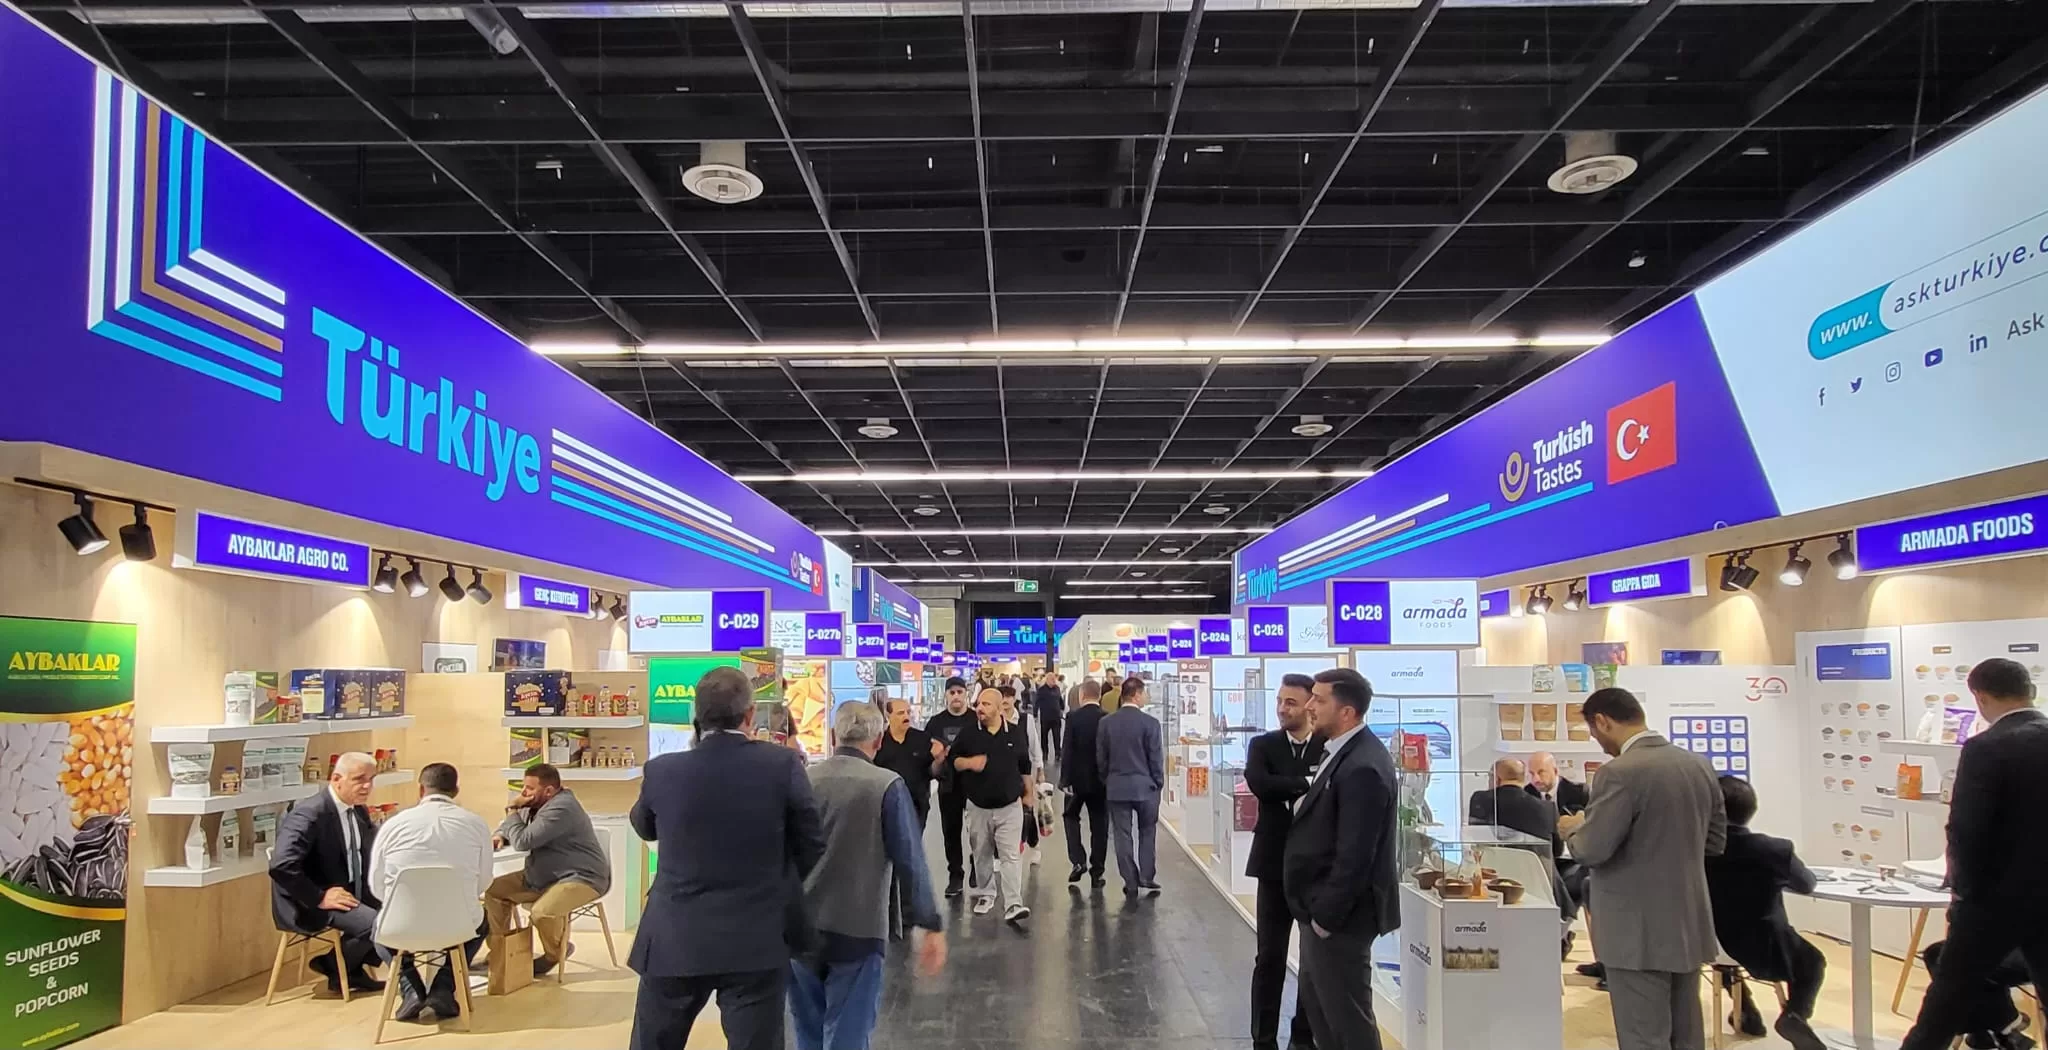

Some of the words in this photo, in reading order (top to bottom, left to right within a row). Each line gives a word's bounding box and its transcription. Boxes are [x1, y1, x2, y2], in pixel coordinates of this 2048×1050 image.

[1820, 312, 1873, 345] www.
[2007, 312, 2044, 340] Ask
[312, 306, 541, 501] Türkiye
[1533, 420, 1593, 465] Turkish
[1533, 460, 1582, 493] Tastes
[1901, 524, 1969, 552] ARMADA
[1972, 512, 2034, 542] FOODS
[228, 533, 295, 563] AYBAKLAR
[297, 546, 329, 569] AGRO
[331, 551, 349, 572] CO.
[1247, 564, 1277, 603] Türkiye
[1612, 576, 1641, 593] GRAPPA
[1641, 573, 1661, 589] GIDA
[1341, 605, 1383, 621] C-028
[1402, 597, 1468, 620] armada
[719, 613, 759, 629] C-029
[775, 620, 793, 631] NÇ
[1253, 624, 1284, 636] C-026
[1419, 621, 1453, 629] FOODS
[807, 628, 841, 640] C-027b
[1172, 639, 1192, 648] C-024
[1201, 633, 1229, 642] C-024a
[8, 651, 120, 671] AYBAKLAR
[1391, 667, 1424, 678] armada
[654, 684, 696, 698] AYBA
[1455, 921, 1487, 933] armada
[5, 929, 101, 966] SUNFLOWER
[28, 951, 79, 977] SEEDS
[46, 976, 57, 989] &
[15, 982, 88, 1018] POPCORN
